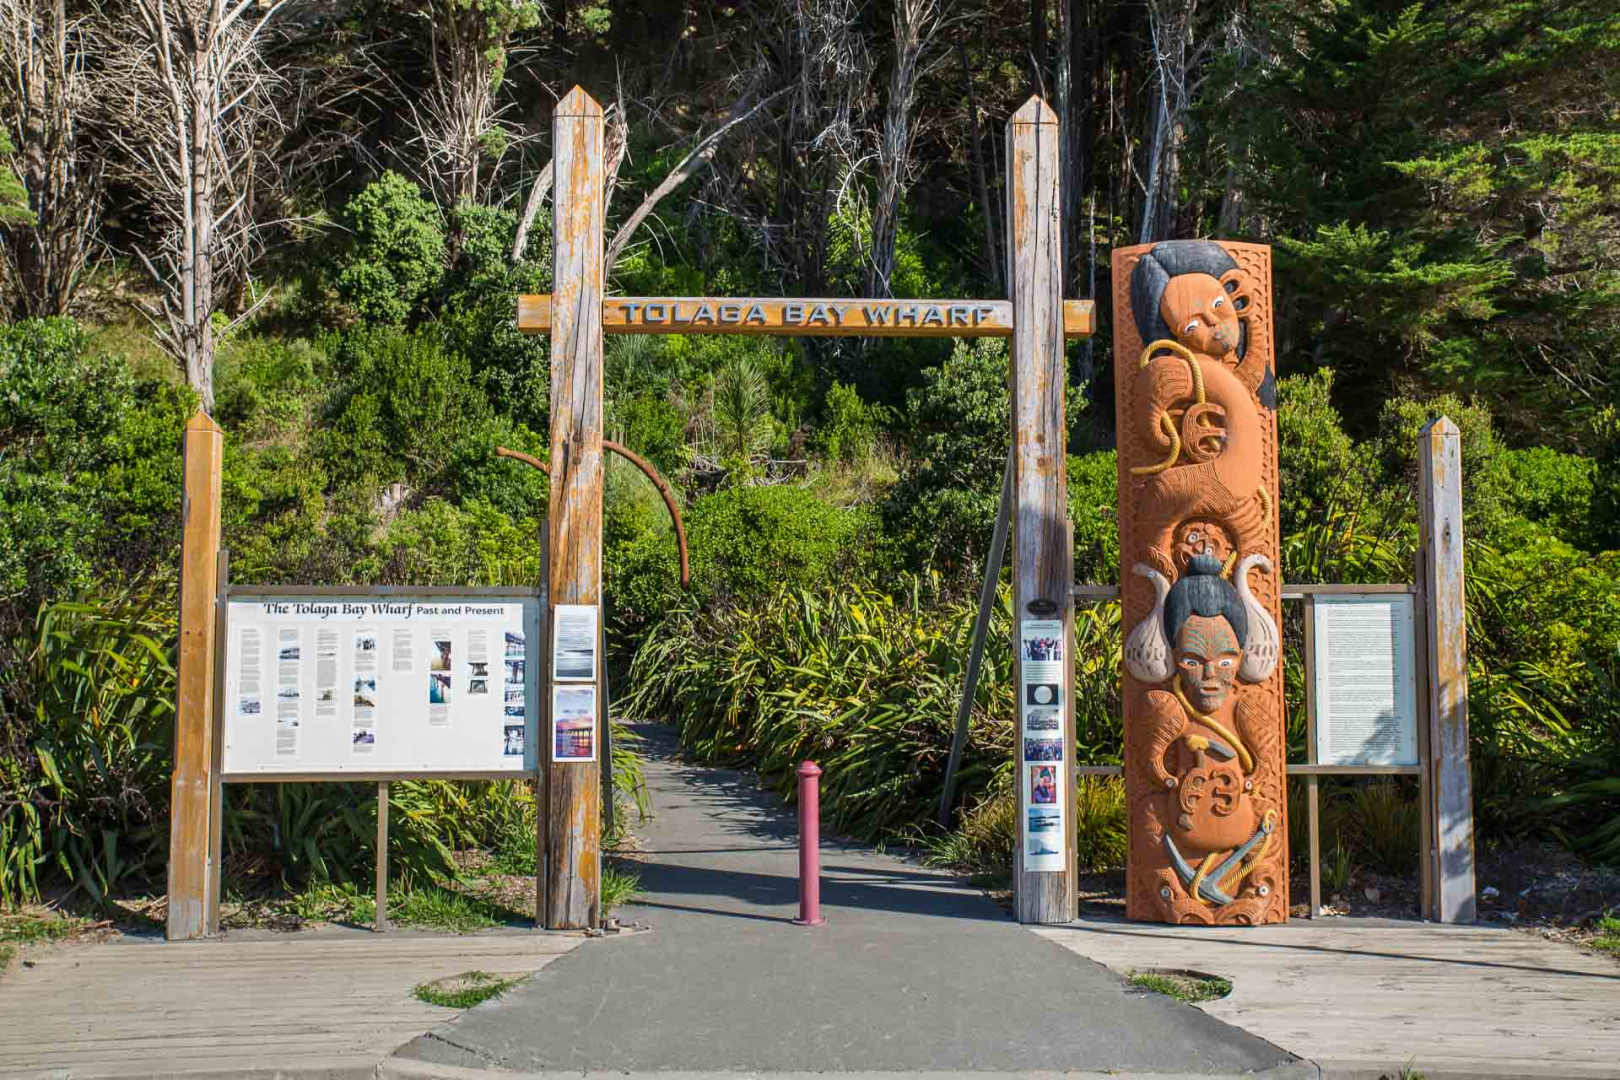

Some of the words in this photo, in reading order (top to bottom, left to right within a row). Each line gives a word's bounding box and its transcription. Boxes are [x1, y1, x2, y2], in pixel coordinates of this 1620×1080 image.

[619, 303, 768, 324] TOLAGA
[783, 304, 850, 325] BAY
[863, 305, 995, 326] WHARF
[263, 602, 289, 614] The
[293, 602, 337, 619] Tolaga
[342, 603, 367, 619] Bay
[371, 602, 414, 619] Wharf
[416, 606, 439, 615] Past
[441, 605, 461, 615] and
[465, 606, 505, 615] Present
